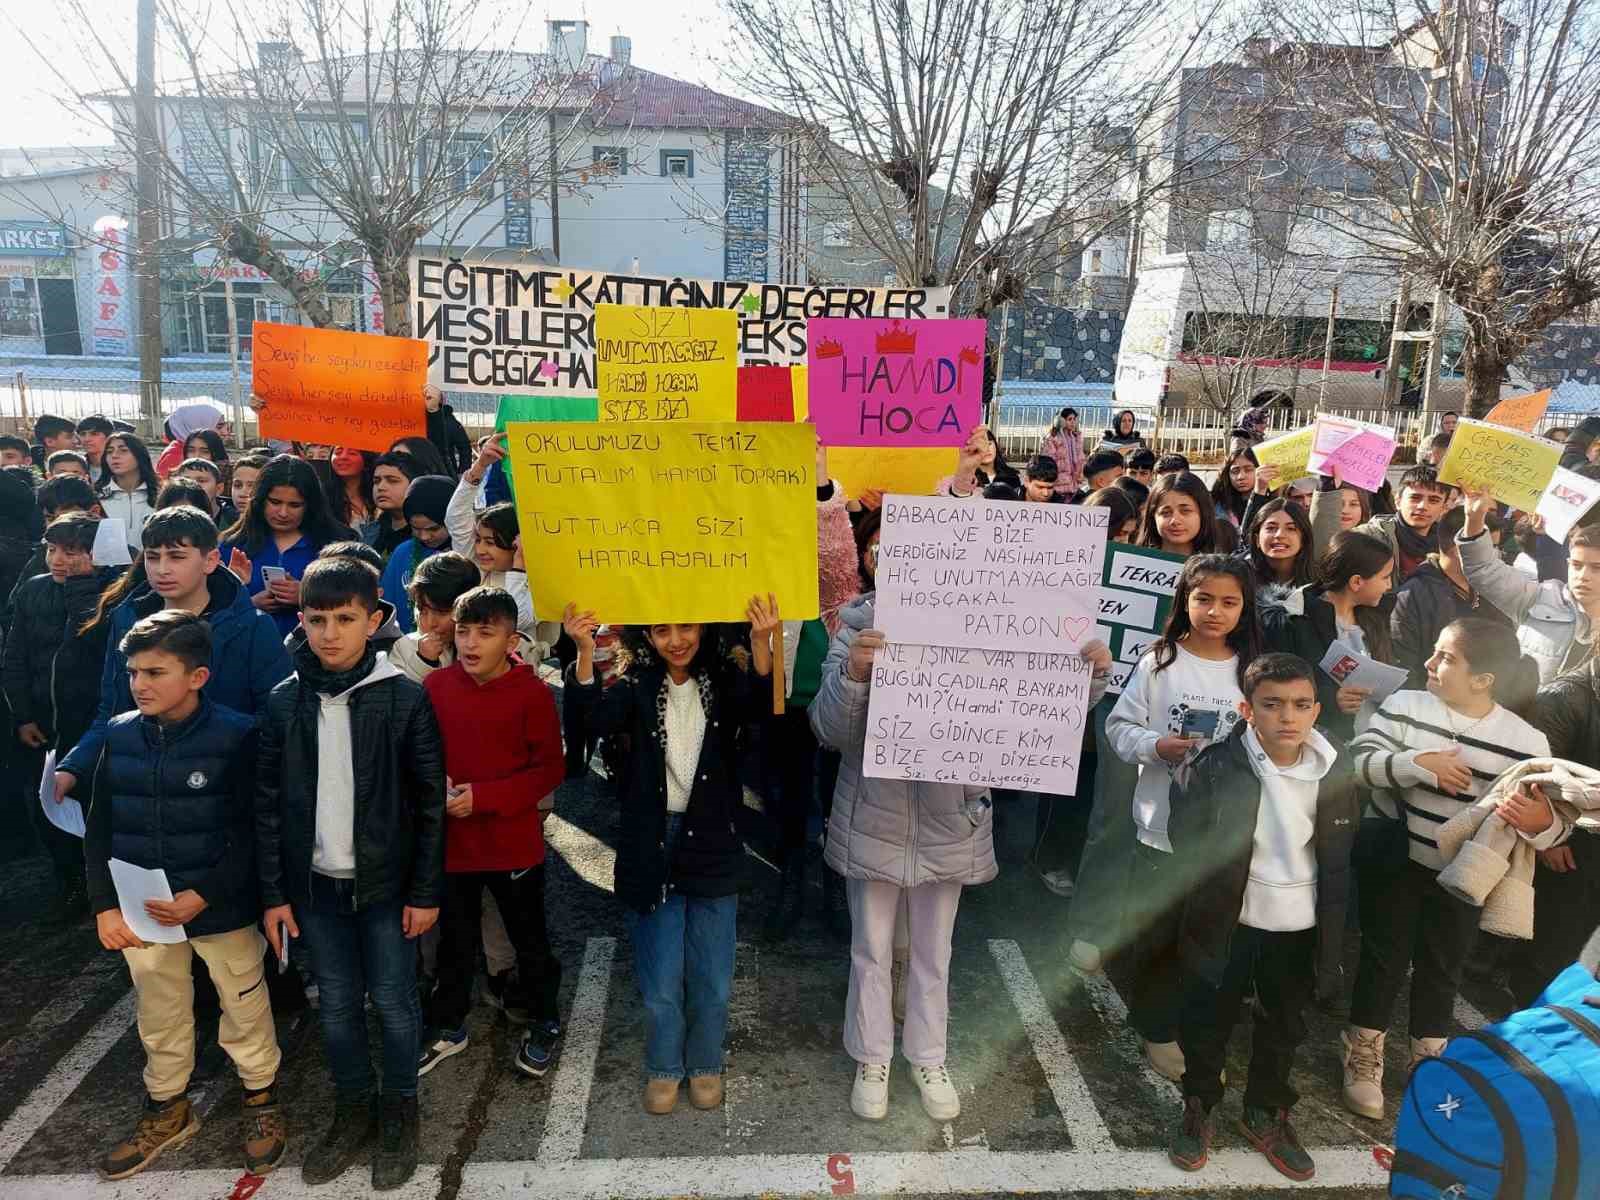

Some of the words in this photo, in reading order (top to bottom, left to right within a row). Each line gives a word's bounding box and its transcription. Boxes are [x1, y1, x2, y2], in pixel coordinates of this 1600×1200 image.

[736, 318, 808, 357] EKS
[551, 351, 598, 390] HA
[860, 399, 962, 436] HOCA
[525, 432, 661, 454] OKULUMUZU
[692, 431, 759, 452] TEMİZ
[529, 463, 635, 485] TUTALIM
[729, 463, 808, 486] TOPRAK)
[696, 515, 745, 537] SİZİ
[885, 503, 976, 524] BABACAN
[985, 508, 1109, 529] DAVRANIŞINIZ
[953, 526, 979, 543] VE
[993, 523, 1035, 544] BİZE
[577, 548, 749, 569] HATIRLAYALIM
[883, 541, 968, 561] VERDİĞİNİZ
[984, 544, 1097, 566] NASİHATLERİ
[887, 562, 919, 585] HİÇ
[934, 567, 1102, 588] UNUTMAYACAĞIZ
[900, 591, 1016, 609] HOŞÇAKAL
[964, 614, 1061, 638] PATRON
[983, 650, 1015, 671] VAR
[1027, 652, 1092, 675] BURADA
[875, 665, 932, 688] BUGÜN
[937, 672, 1009, 695] CADILAR
[1017, 679, 1084, 702] BAYRAMI
[1009, 700, 1083, 729] TOPRAK)
[873, 714, 916, 741] SİZ
[930, 719, 1009, 745] GİDİNCE
[1017, 727, 1054, 749] KİM
[874, 743, 928, 766] BİZE
[942, 750, 984, 765] CADI
[1000, 751, 1075, 771] DİYECEK
[903, 766, 926, 779] Sizi
[935, 769, 959, 782] Çok
